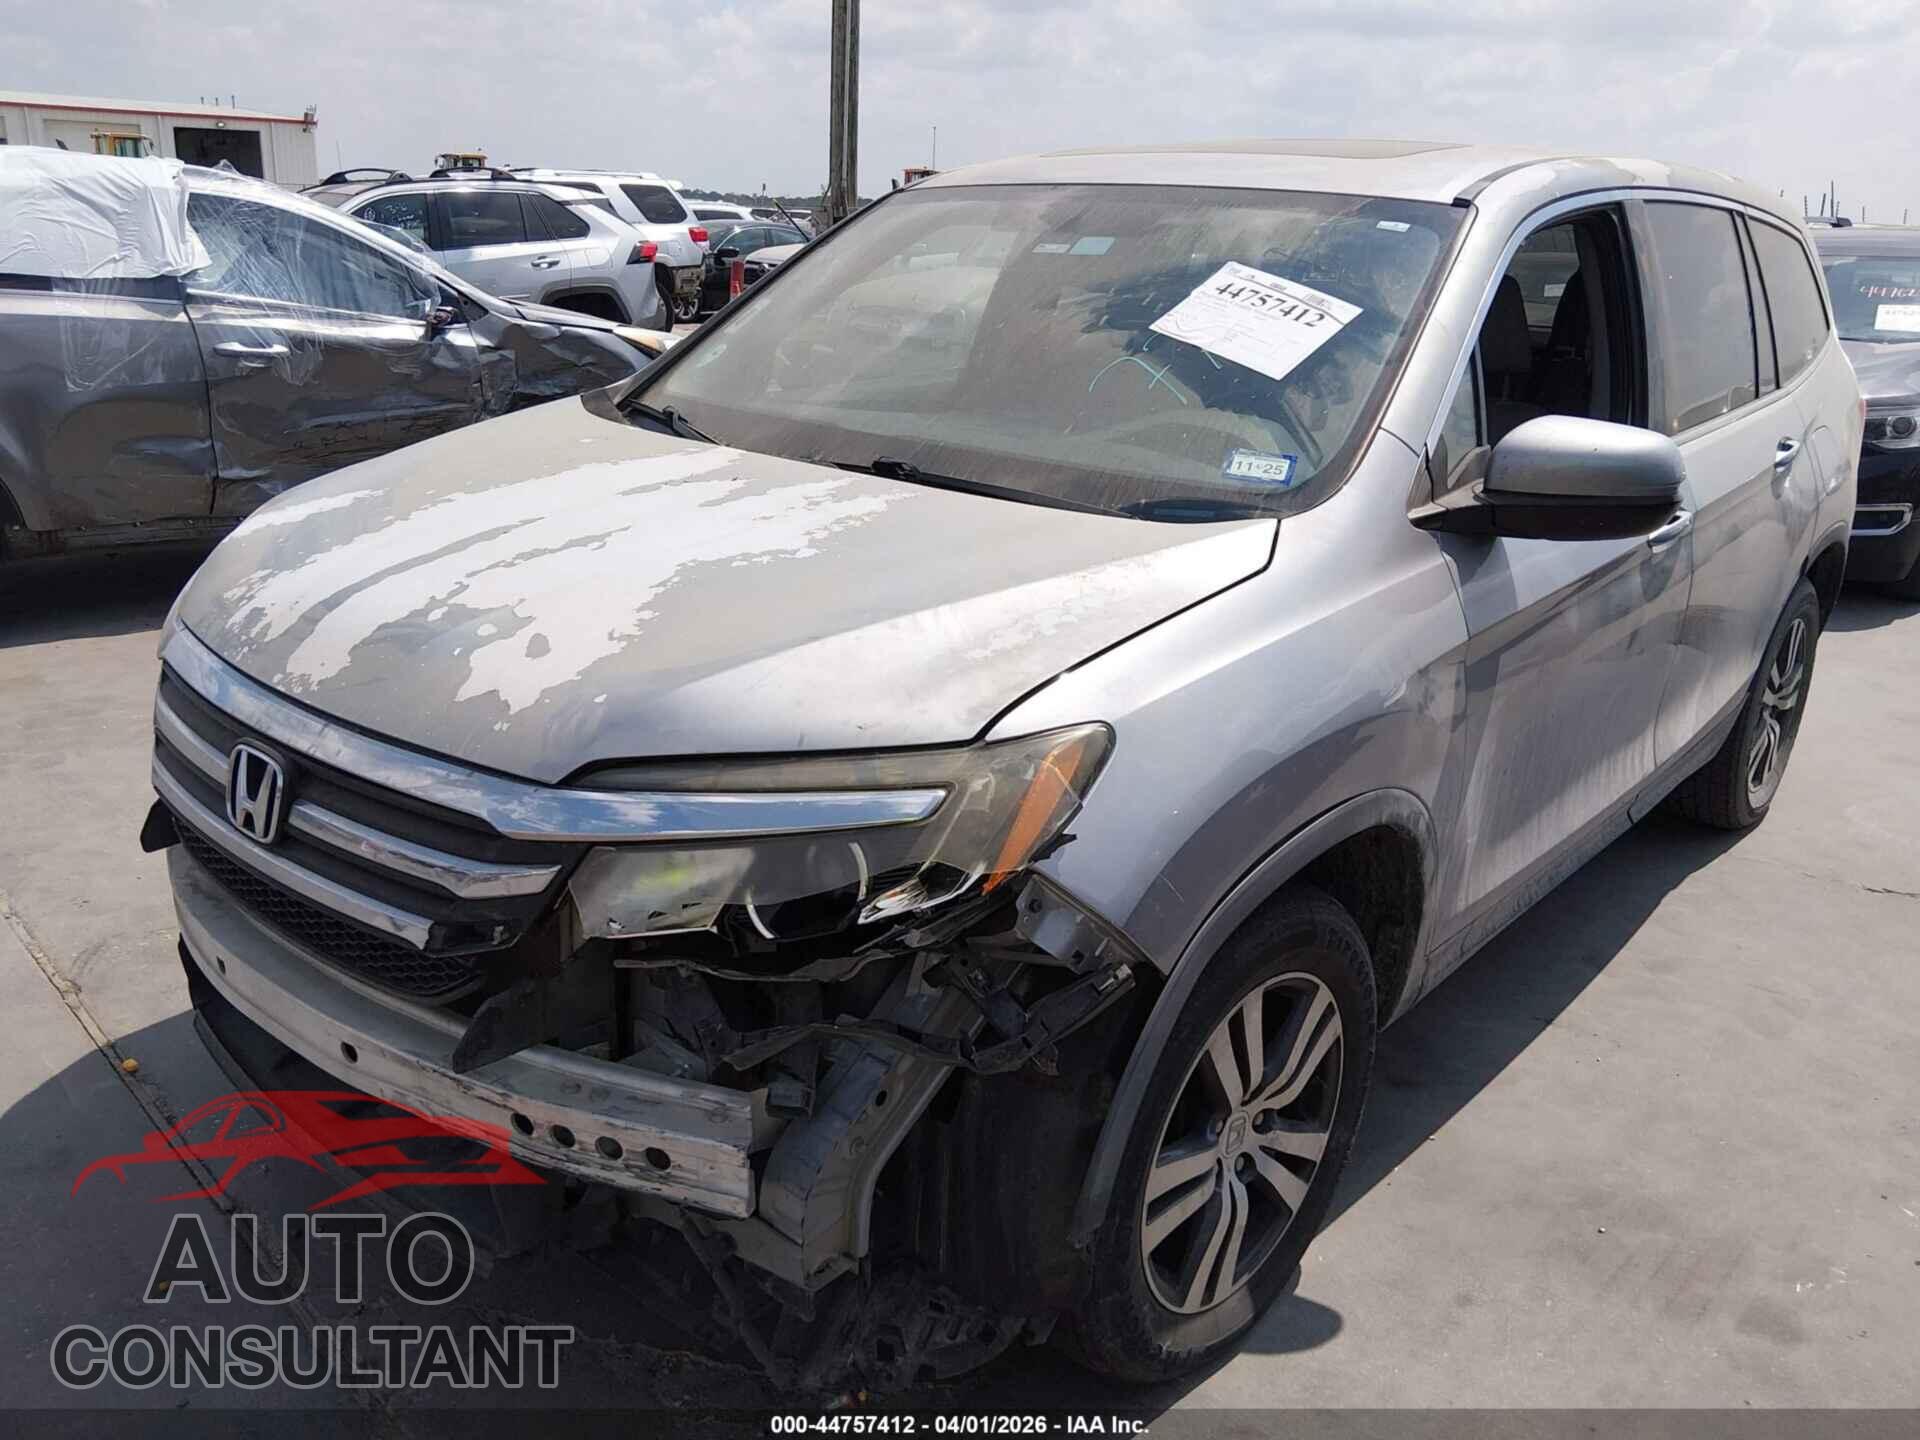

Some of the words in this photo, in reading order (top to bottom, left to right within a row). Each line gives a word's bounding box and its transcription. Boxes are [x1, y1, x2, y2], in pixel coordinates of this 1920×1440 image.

[1215, 281, 1326, 327] 44757412
[1234, 460, 1254, 472] 11
[1262, 463, 1284, 476] 25
